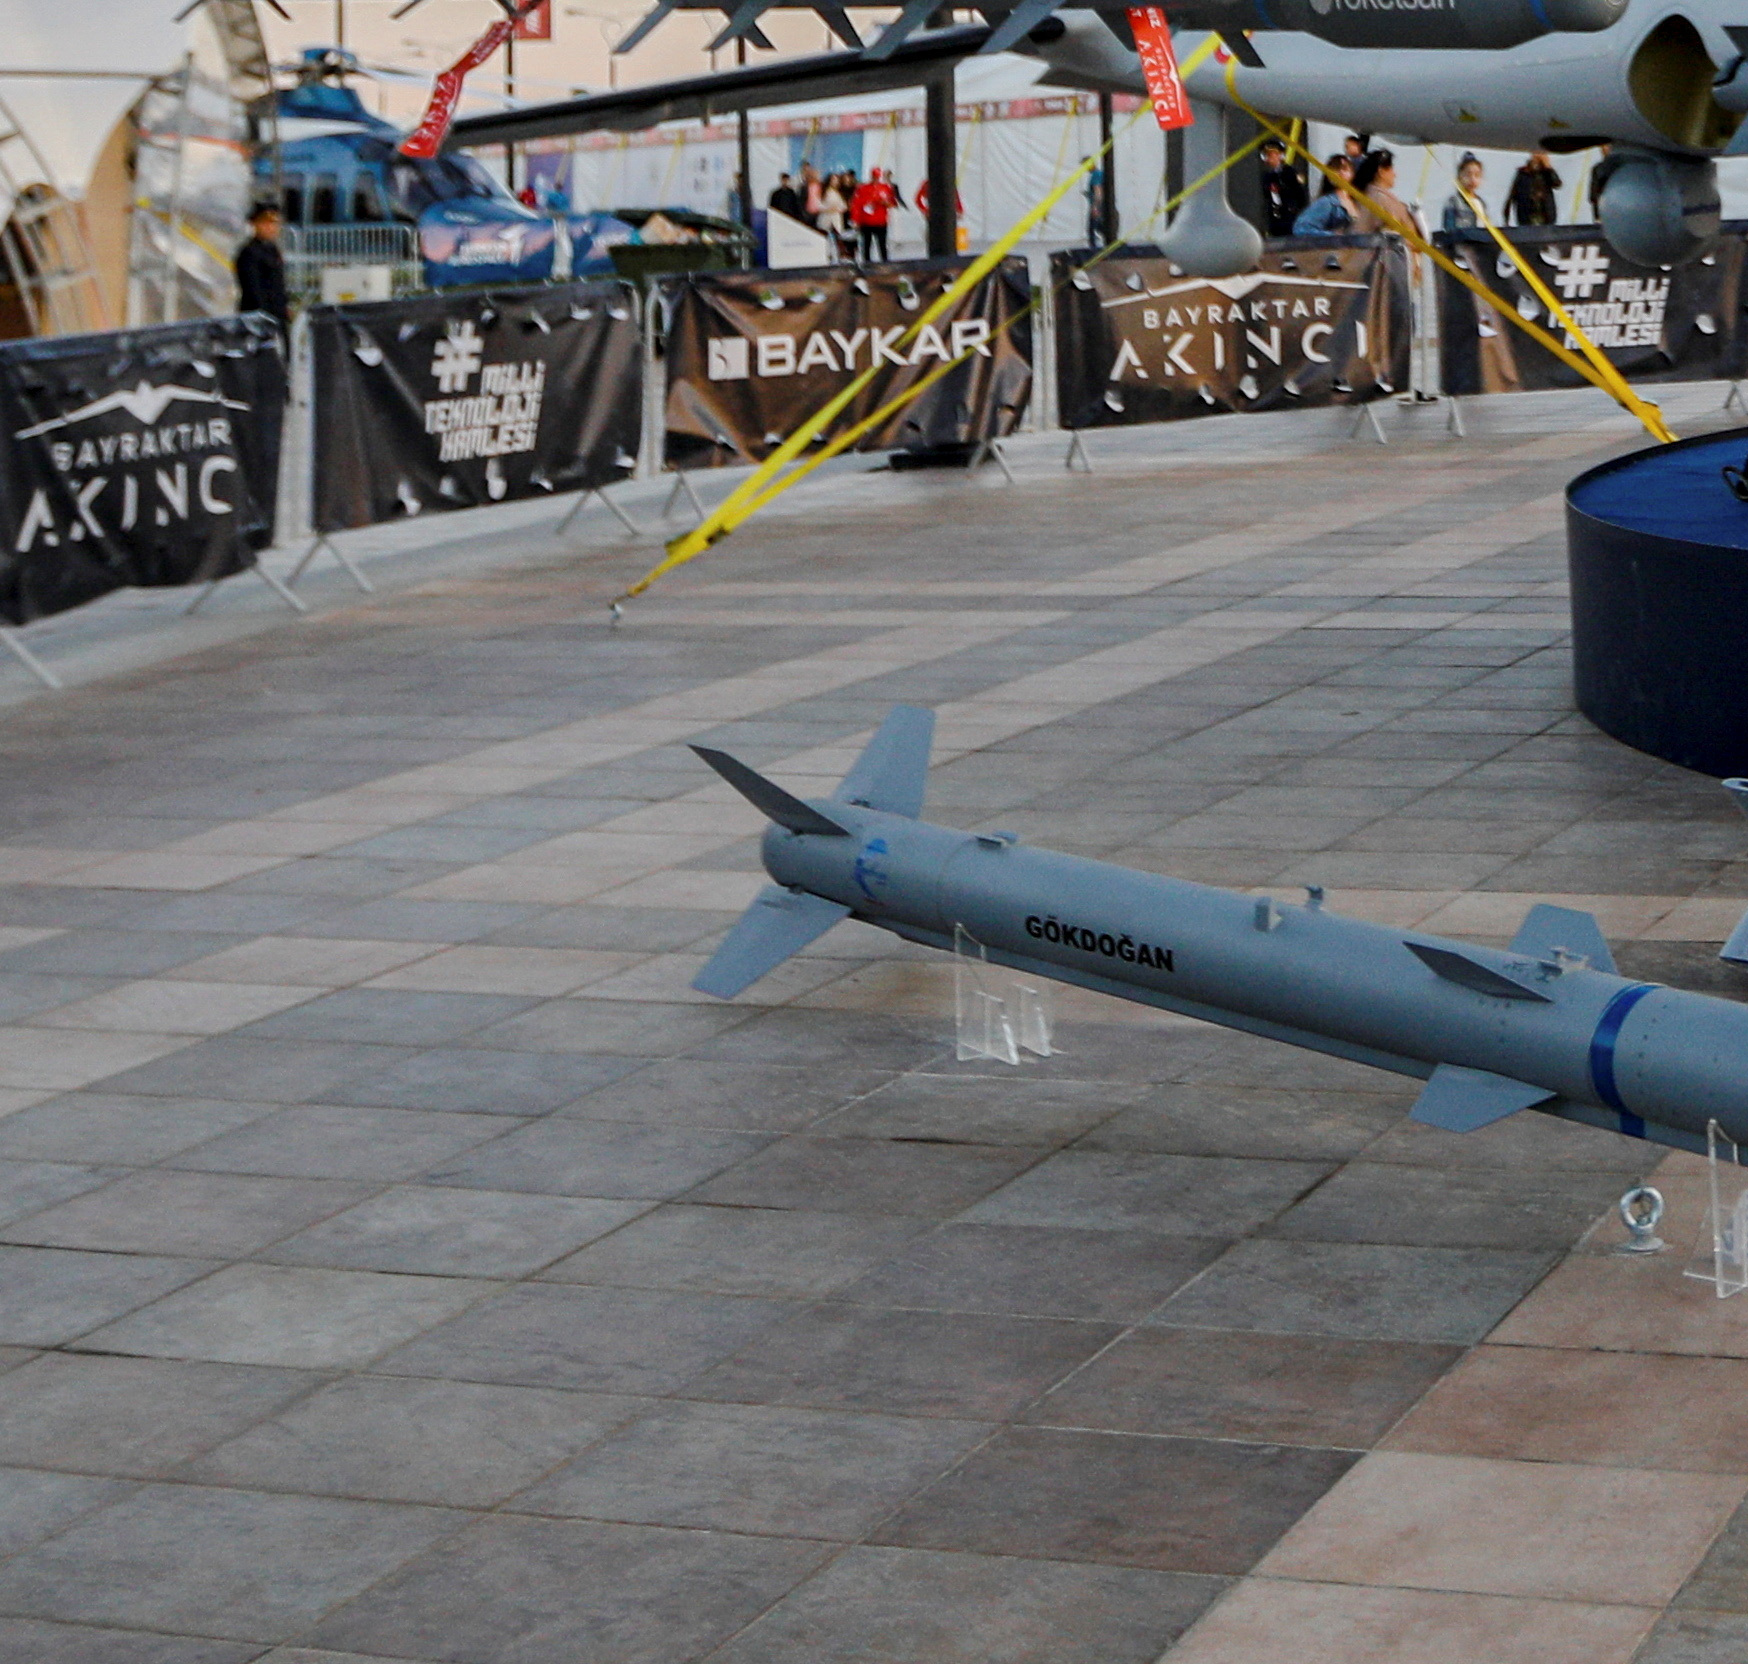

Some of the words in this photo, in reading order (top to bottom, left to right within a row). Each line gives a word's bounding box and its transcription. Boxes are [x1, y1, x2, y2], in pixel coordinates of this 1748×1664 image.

[1138, 39, 1172, 123] AKINCI
[1142, 296, 1332, 330] BAYRAKTAR
[756, 317, 993, 378] BAYKAR
[1109, 320, 1369, 382] AKINCI
[52, 416, 233, 472] BAYRAKTAR
[14, 454, 238, 554] AKINC
[1024, 914, 1176, 973] GÖKDOĞAN
